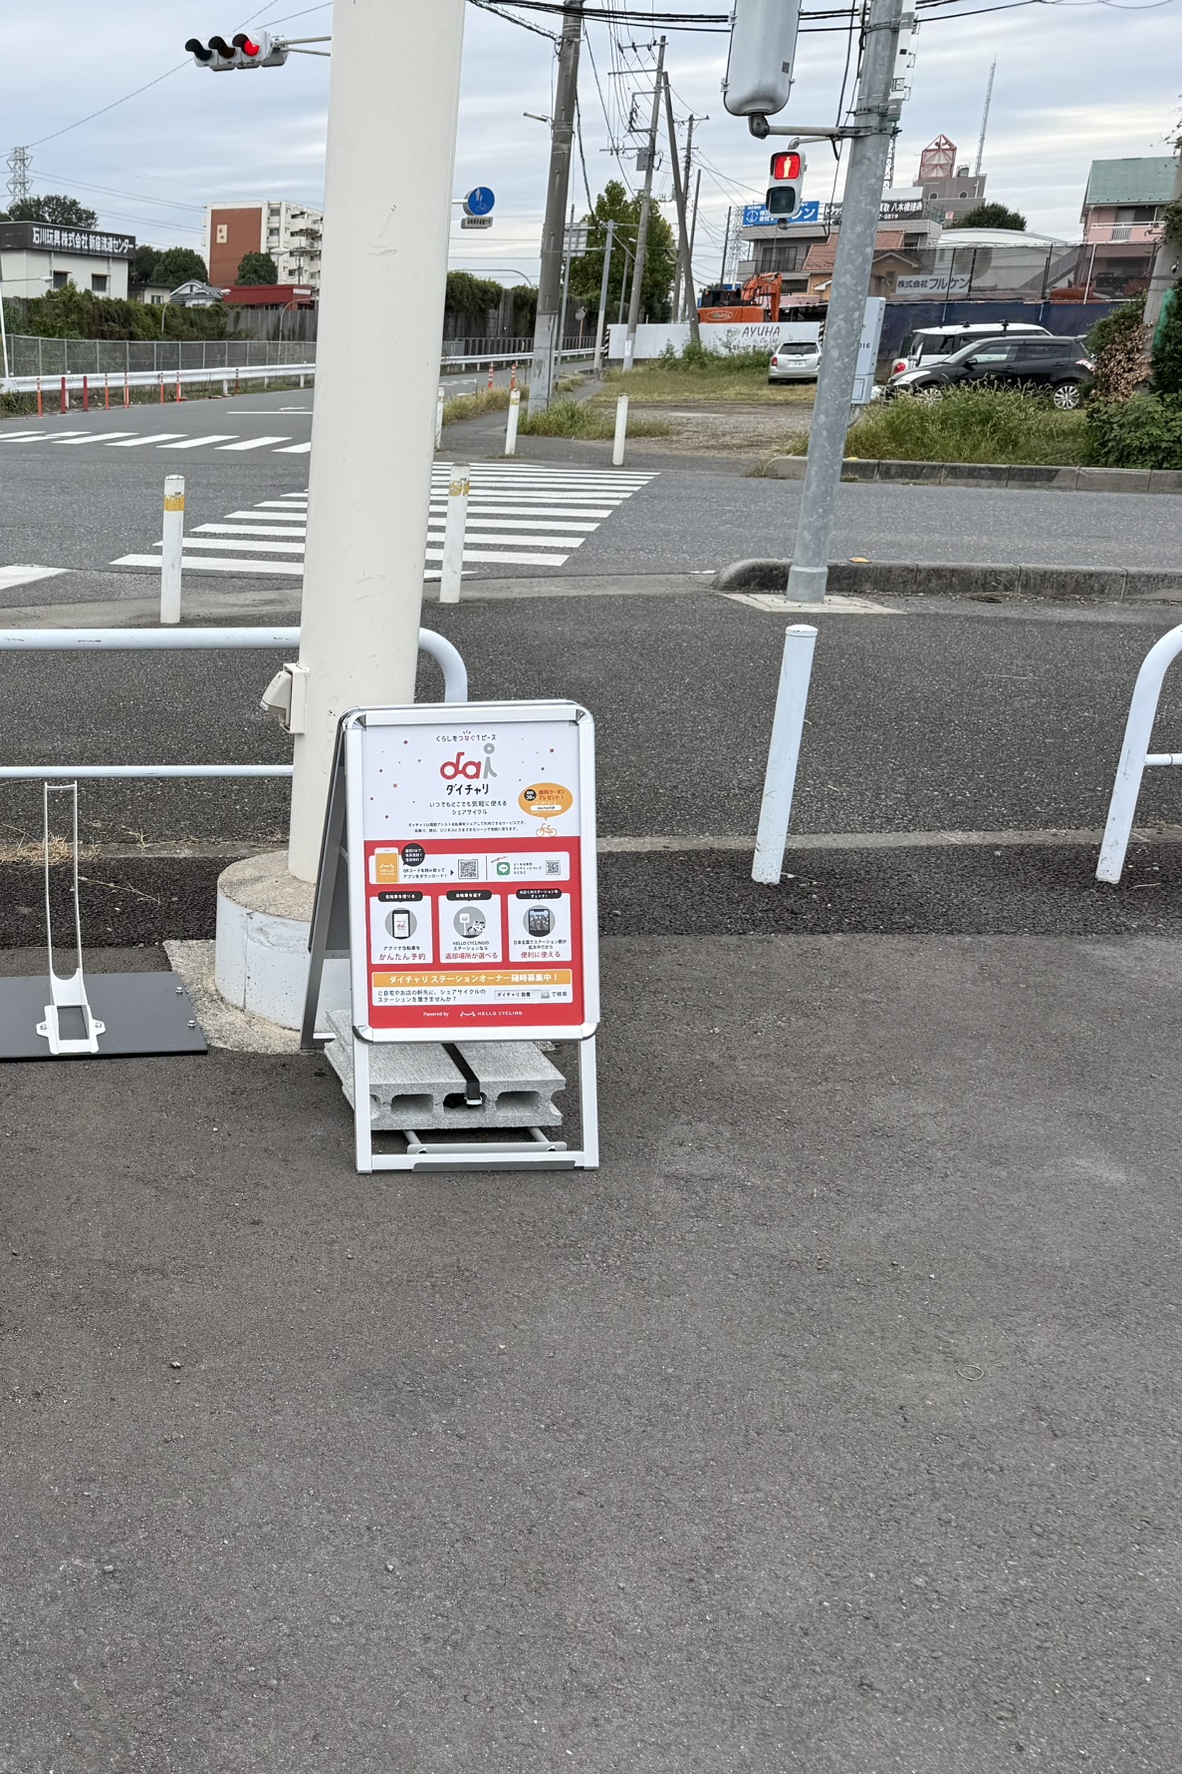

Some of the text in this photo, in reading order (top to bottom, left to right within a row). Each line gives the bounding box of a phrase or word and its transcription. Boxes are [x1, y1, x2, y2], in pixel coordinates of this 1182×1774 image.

[61, 231, 88, 249] 株式会社
[741, 325, 780, 338] AYUHA
[440, 743, 498, 779] dai
[446, 783, 489, 796] ダイチャリ
[429, 800, 507, 808] いつでもどこでも気軽に使える
[379, 953, 426, 961] かんたん予約
[445, 952, 499, 960] 返却場所が選べる
[520, 951, 561, 959] 便利に使える
[389, 975, 428, 984] ダイチャリ
